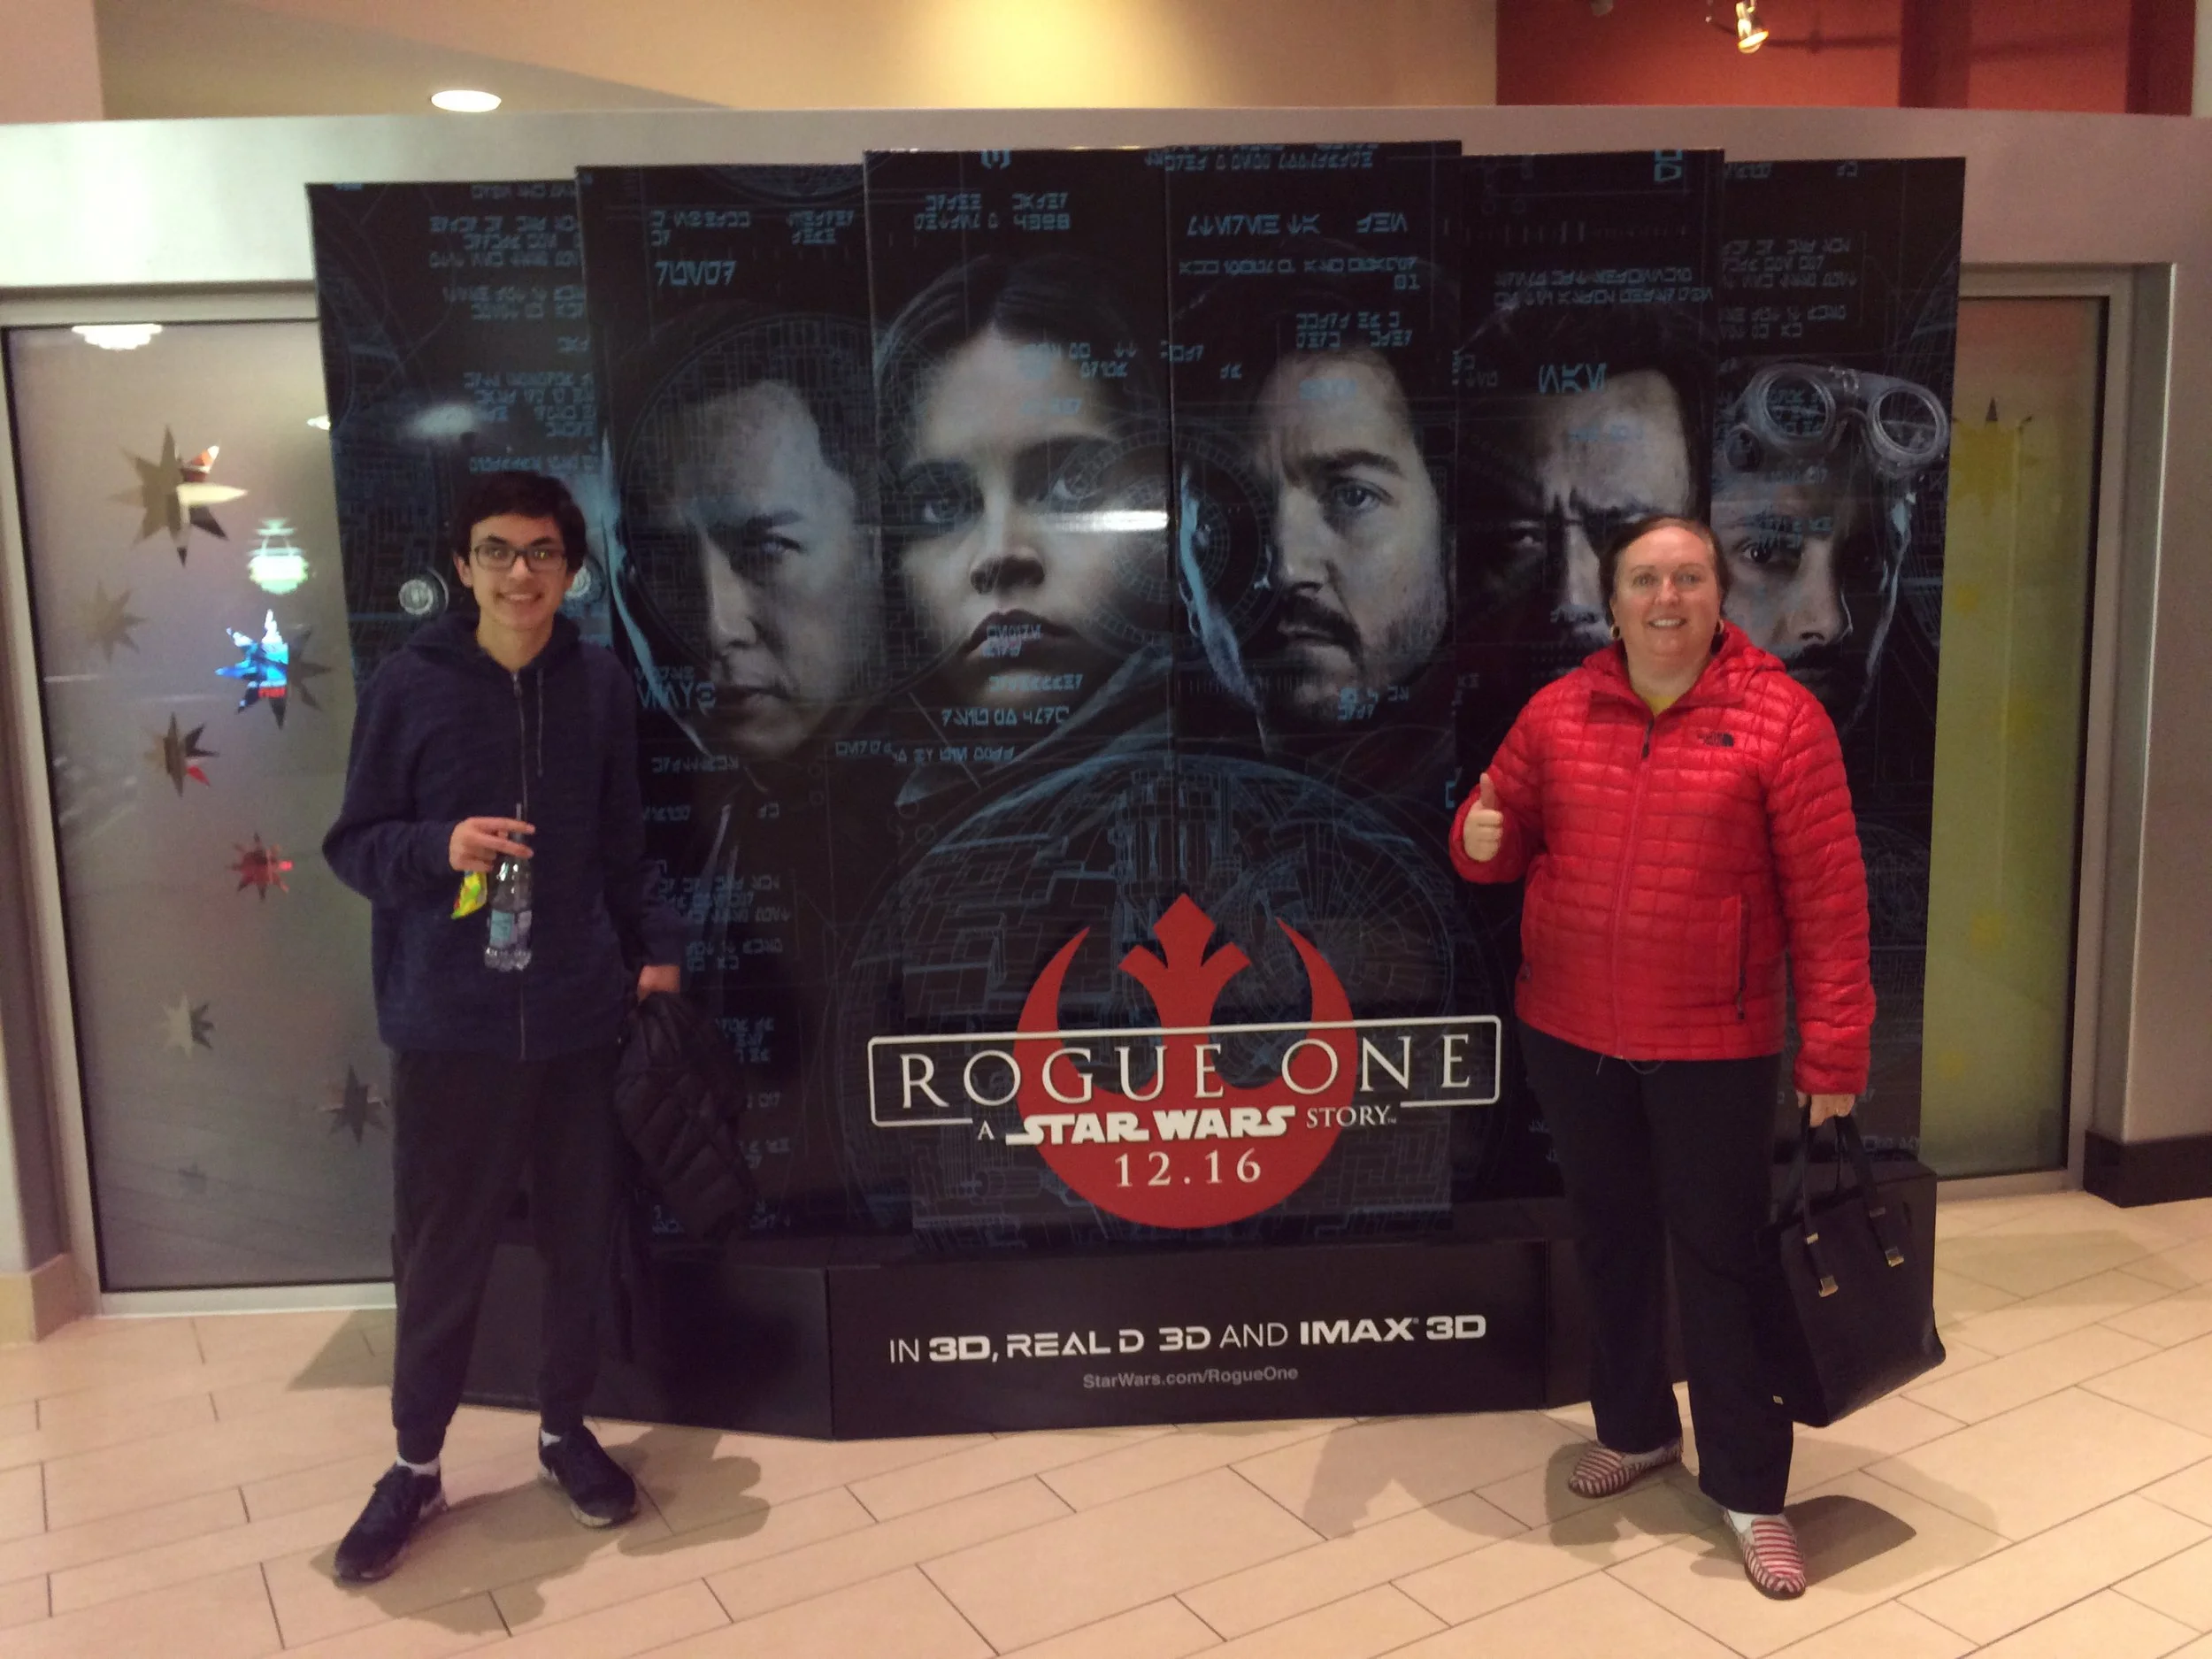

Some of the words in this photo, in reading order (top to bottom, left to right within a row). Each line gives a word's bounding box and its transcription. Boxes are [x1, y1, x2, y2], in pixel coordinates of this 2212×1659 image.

[898, 1040, 1225, 1109] ROGUE
[1279, 1031, 1472, 1095] ONE
[977, 1119, 996, 1141] A
[1005, 1111, 1149, 1147] STAR
[1152, 1104, 1297, 1141] WARS
[1113, 1148, 1263, 1189] 12.16
[889, 1338, 920, 1364] IN
[1158, 1325, 1212, 1352] 3D
[1219, 1321, 1289, 1349] AND
[1425, 1314, 1487, 1340] 3D
[1083, 1365, 1300, 1390] StarWars.com/RogueOne
